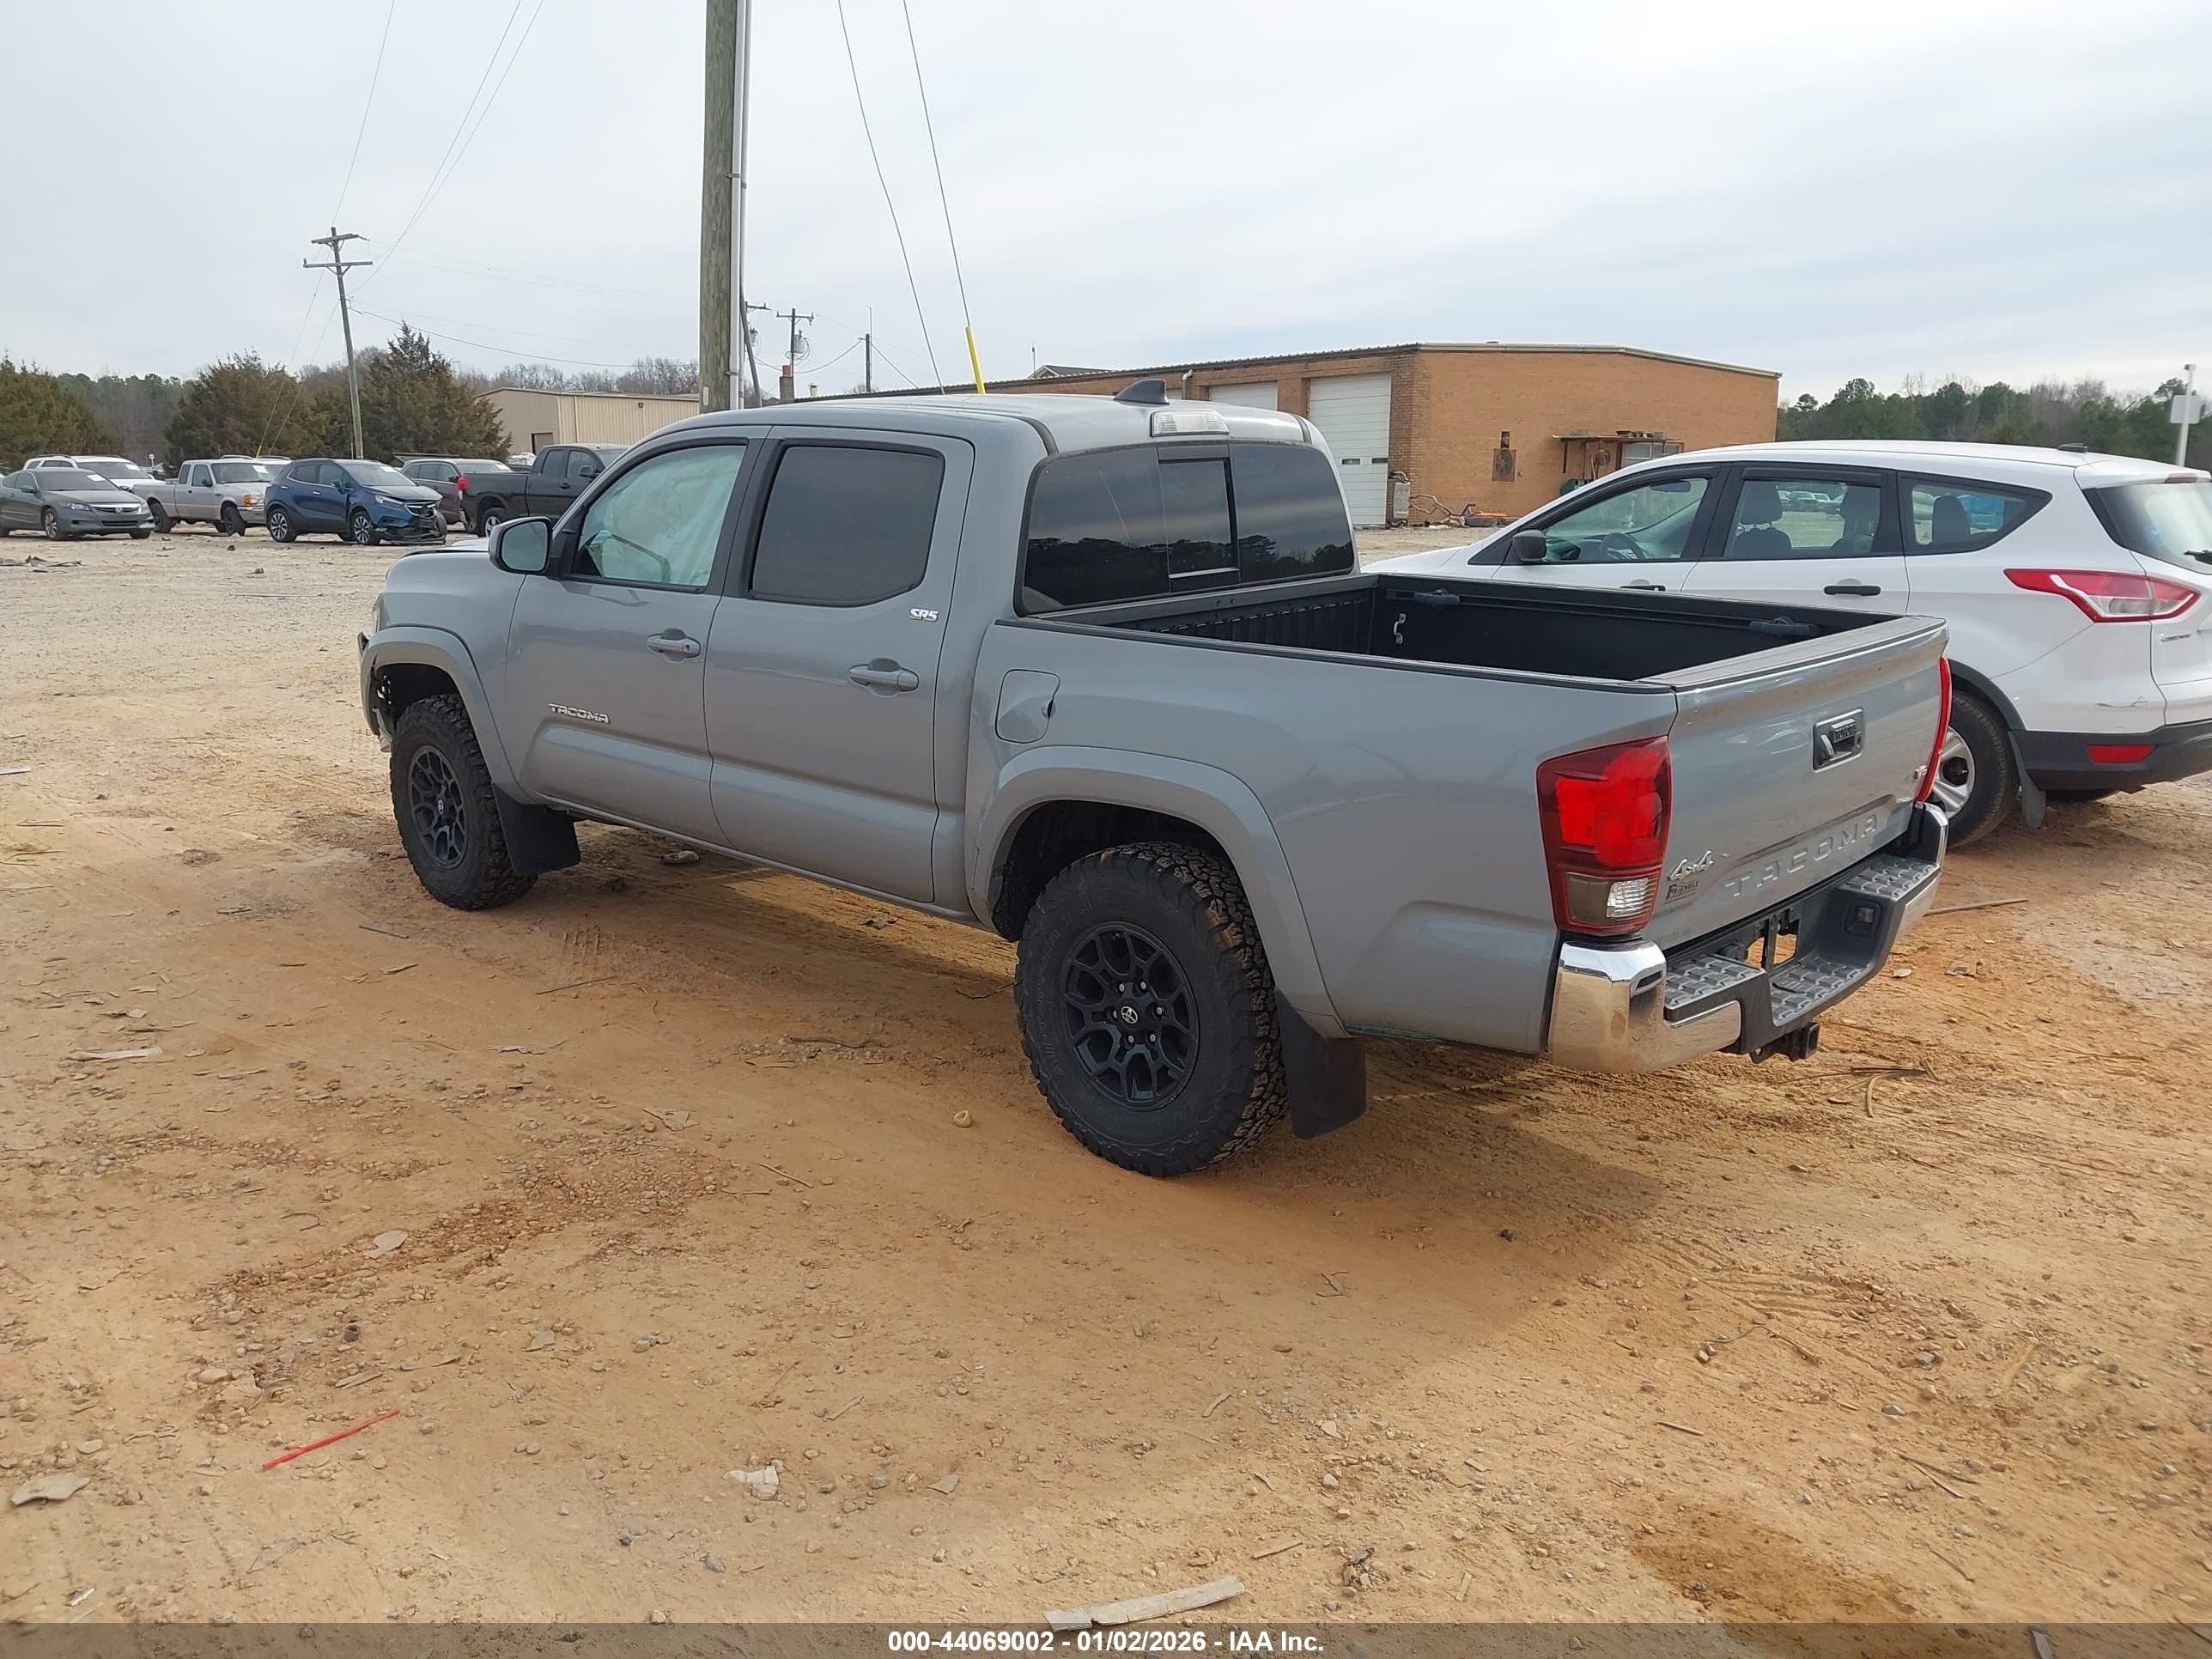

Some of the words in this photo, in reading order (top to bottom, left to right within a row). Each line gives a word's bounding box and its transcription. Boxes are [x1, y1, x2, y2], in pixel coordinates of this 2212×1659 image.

[909, 608, 939, 622] SR5
[548, 702, 610, 724] TACOMA
[1724, 814, 1877, 897] TACOMA
